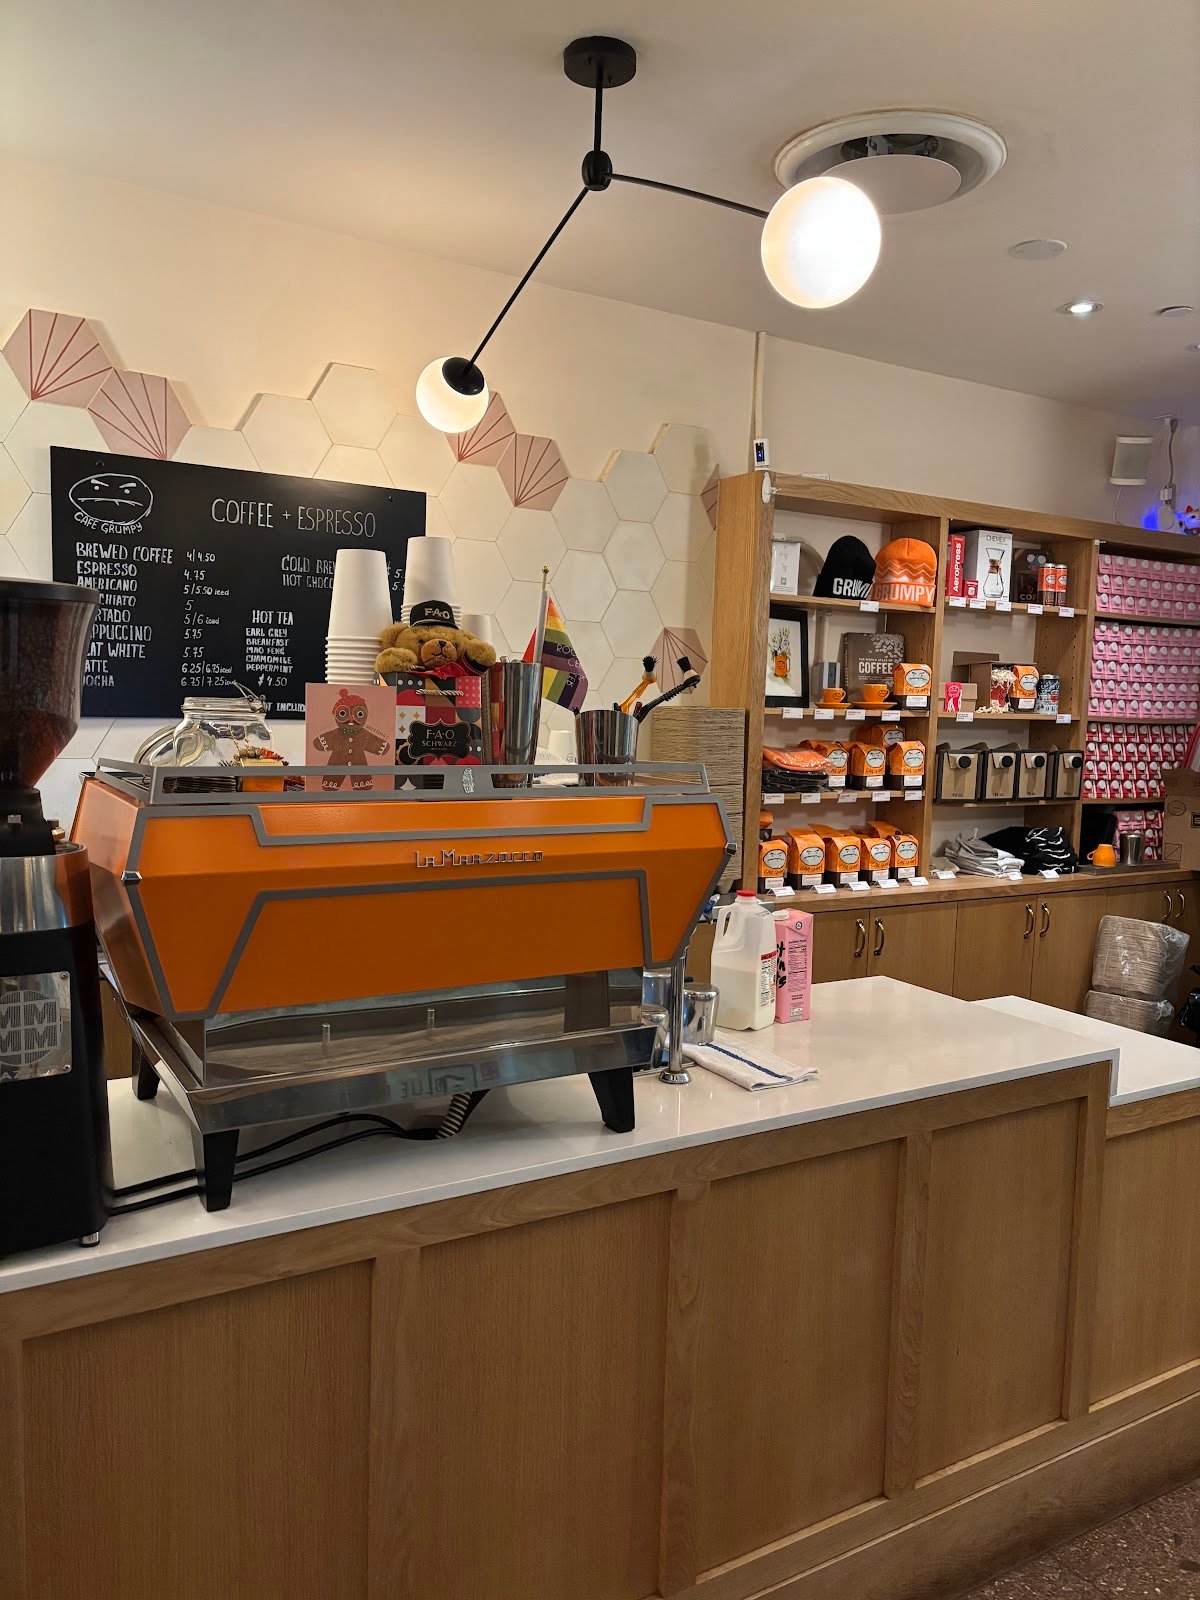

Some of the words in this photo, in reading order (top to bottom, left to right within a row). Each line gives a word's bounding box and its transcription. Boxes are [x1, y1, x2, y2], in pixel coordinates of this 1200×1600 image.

[74, 511, 99, 530] CAFE
[100, 521, 143, 535] GRUMPY
[211, 498, 274, 528] COFFEE
[297, 505, 376, 538] ESPRESSO
[75, 541, 128, 561] BREWED
[132, 545, 174, 564] COFFEE
[76, 560, 138, 577] ESPRESSO
[183, 569, 206, 581] 4.75
[281, 554, 310, 573] COLD
[282, 573, 302, 587] HOT
[99, 593, 137, 607] CHIATO
[184, 599, 194, 611] 5
[875, 584, 935, 603] GRUMPY
[94, 608, 131, 623] RTADO
[252, 609, 274, 625] HOT
[276, 611, 294, 626] TEA
[91, 624, 152, 642] PPUCCINO
[245, 627, 266, 637] EARL
[268, 628, 288, 638] GREY
[87, 642, 104, 657] AT
[107, 642, 146, 659] WHITE
[182, 646, 205, 658] 5.75
[245, 638, 290, 647] BREAKFAST
[84, 659, 109, 674] ATTE
[245, 655, 292, 665] CHAMOMILE
[246, 663, 294, 674] PEPPERMINT
[858, 661, 893, 675] COFFEE
[276, 702, 306, 712] INCLUD
